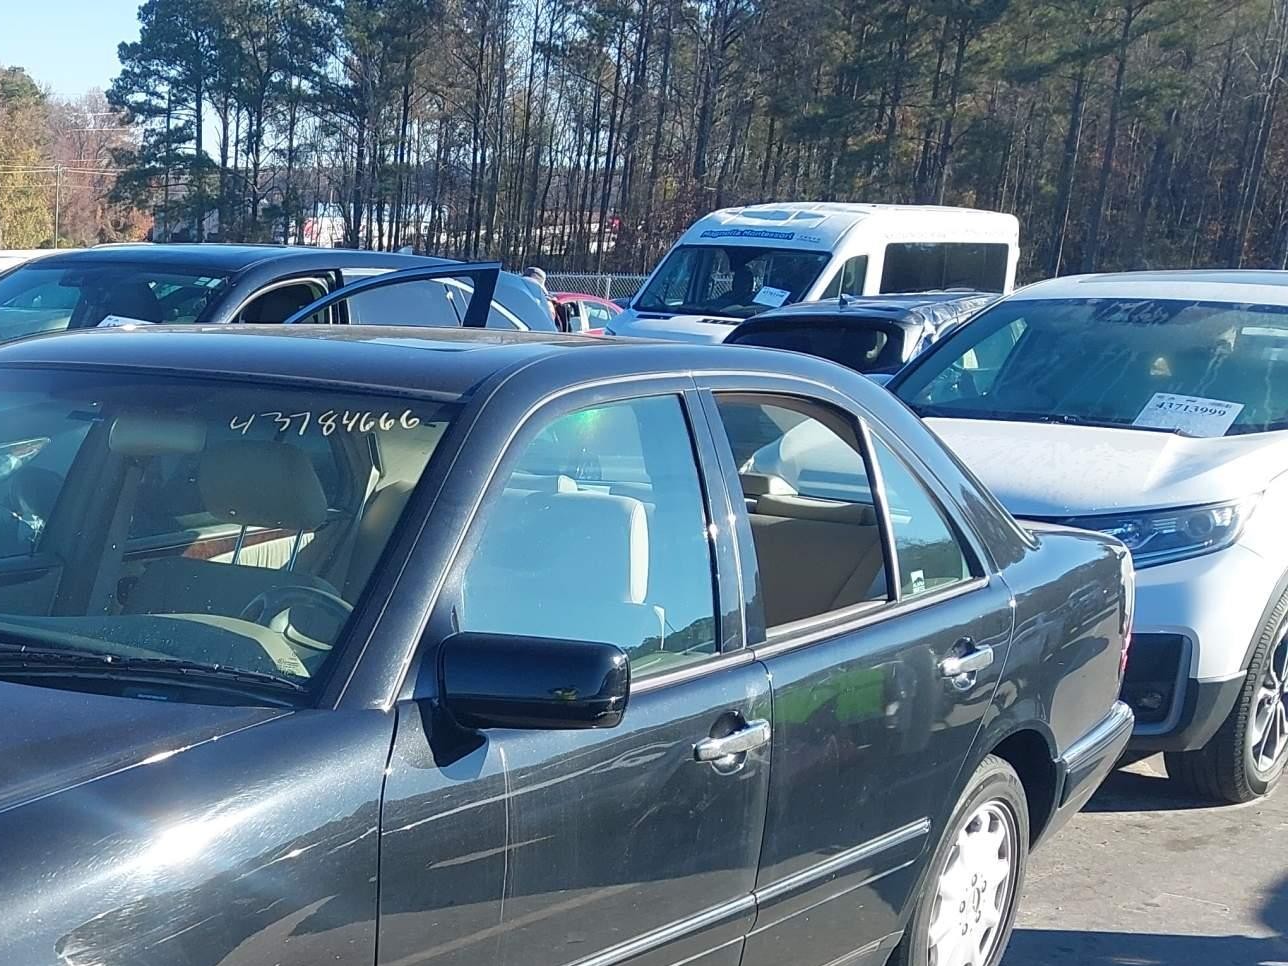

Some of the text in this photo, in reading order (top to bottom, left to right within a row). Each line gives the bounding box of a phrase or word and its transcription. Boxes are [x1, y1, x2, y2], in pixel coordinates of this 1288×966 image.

[742, 230, 794, 240] Montessori
[1156, 401, 1227, 417] 43713999
[229, 409, 421, 436] 43784666
